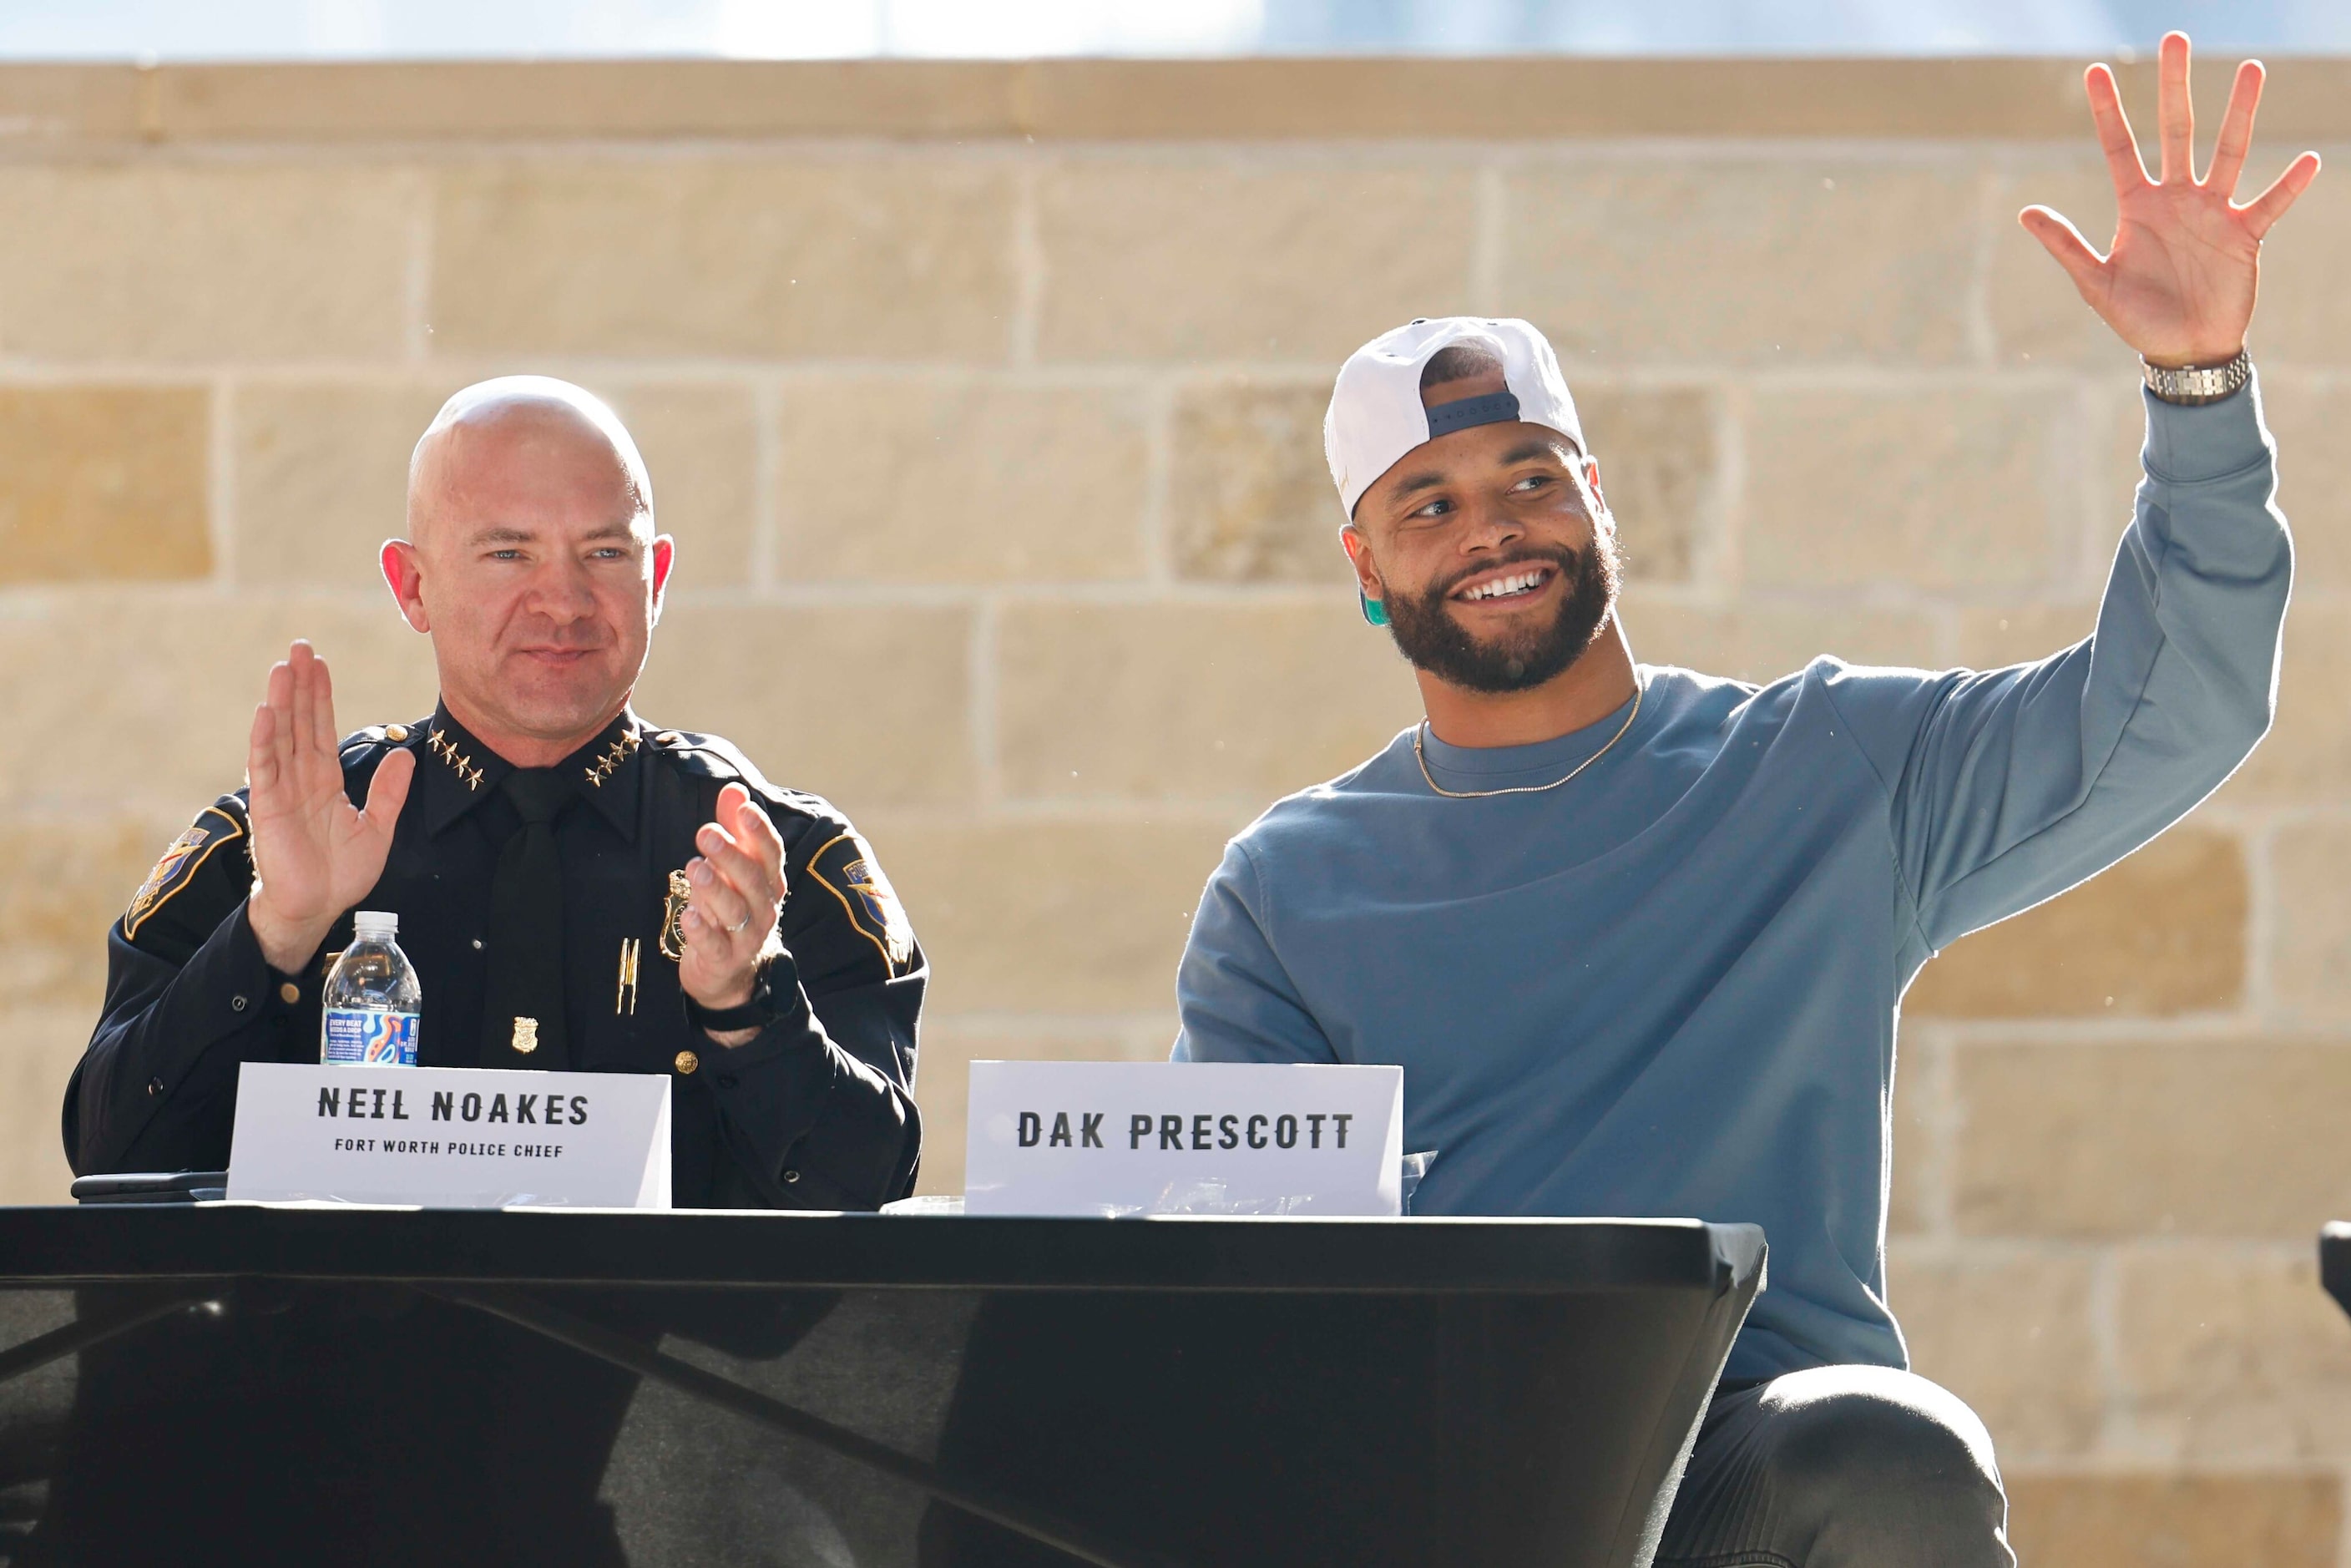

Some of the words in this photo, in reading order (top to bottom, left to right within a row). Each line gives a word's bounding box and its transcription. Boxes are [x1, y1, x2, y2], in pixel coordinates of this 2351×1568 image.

[317, 1087, 409, 1120] NEIL
[431, 1091, 589, 1125] NOAKES
[335, 1138, 376, 1152] FORT
[383, 1140, 439, 1155] WORTH
[447, 1142, 506, 1156] POLICE
[513, 1144, 563, 1158] CHIEF
[1017, 1111, 1104, 1149] DAK
[1129, 1114, 1352, 1151] PRESCOTT
